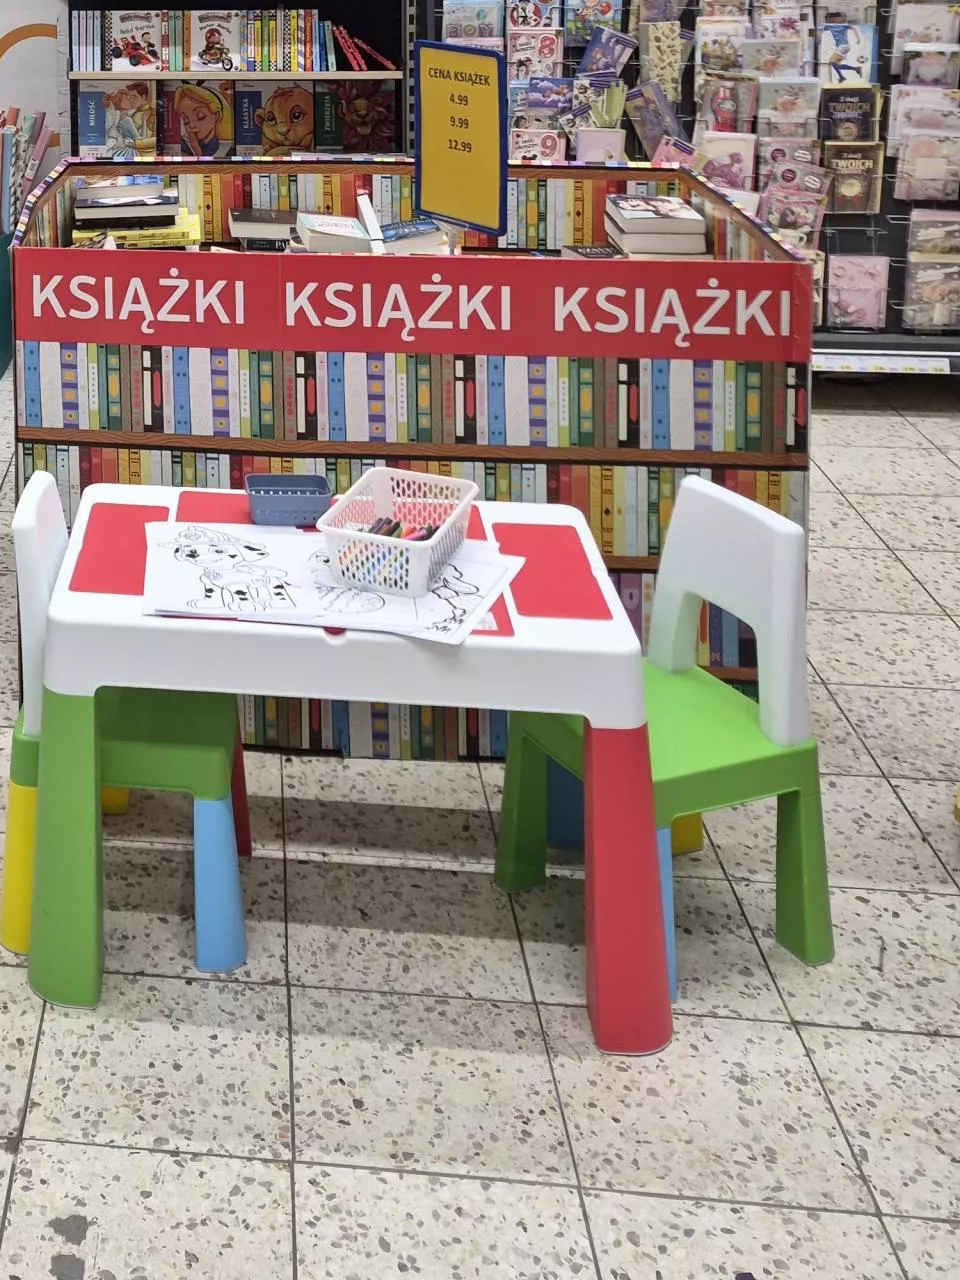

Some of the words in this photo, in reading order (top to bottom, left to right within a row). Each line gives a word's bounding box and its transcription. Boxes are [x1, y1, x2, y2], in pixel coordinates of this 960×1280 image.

[538, 34, 556, 59] 8
[428, 67, 453, 81] CENA
[453, 70, 491, 87] KSIĄŻEK
[449, 93, 468, 106] 4.99
[450, 116, 469, 129] 9.99
[447, 138, 472, 153] 12.99
[540, 134, 559, 158] 9
[831, 159, 874, 169] TWOICH
[32, 267, 245, 334] KSIĄŻKI
[286, 272, 511, 342] KSIĄŻKI
[554, 277, 791, 348] KSIĄŻKI
